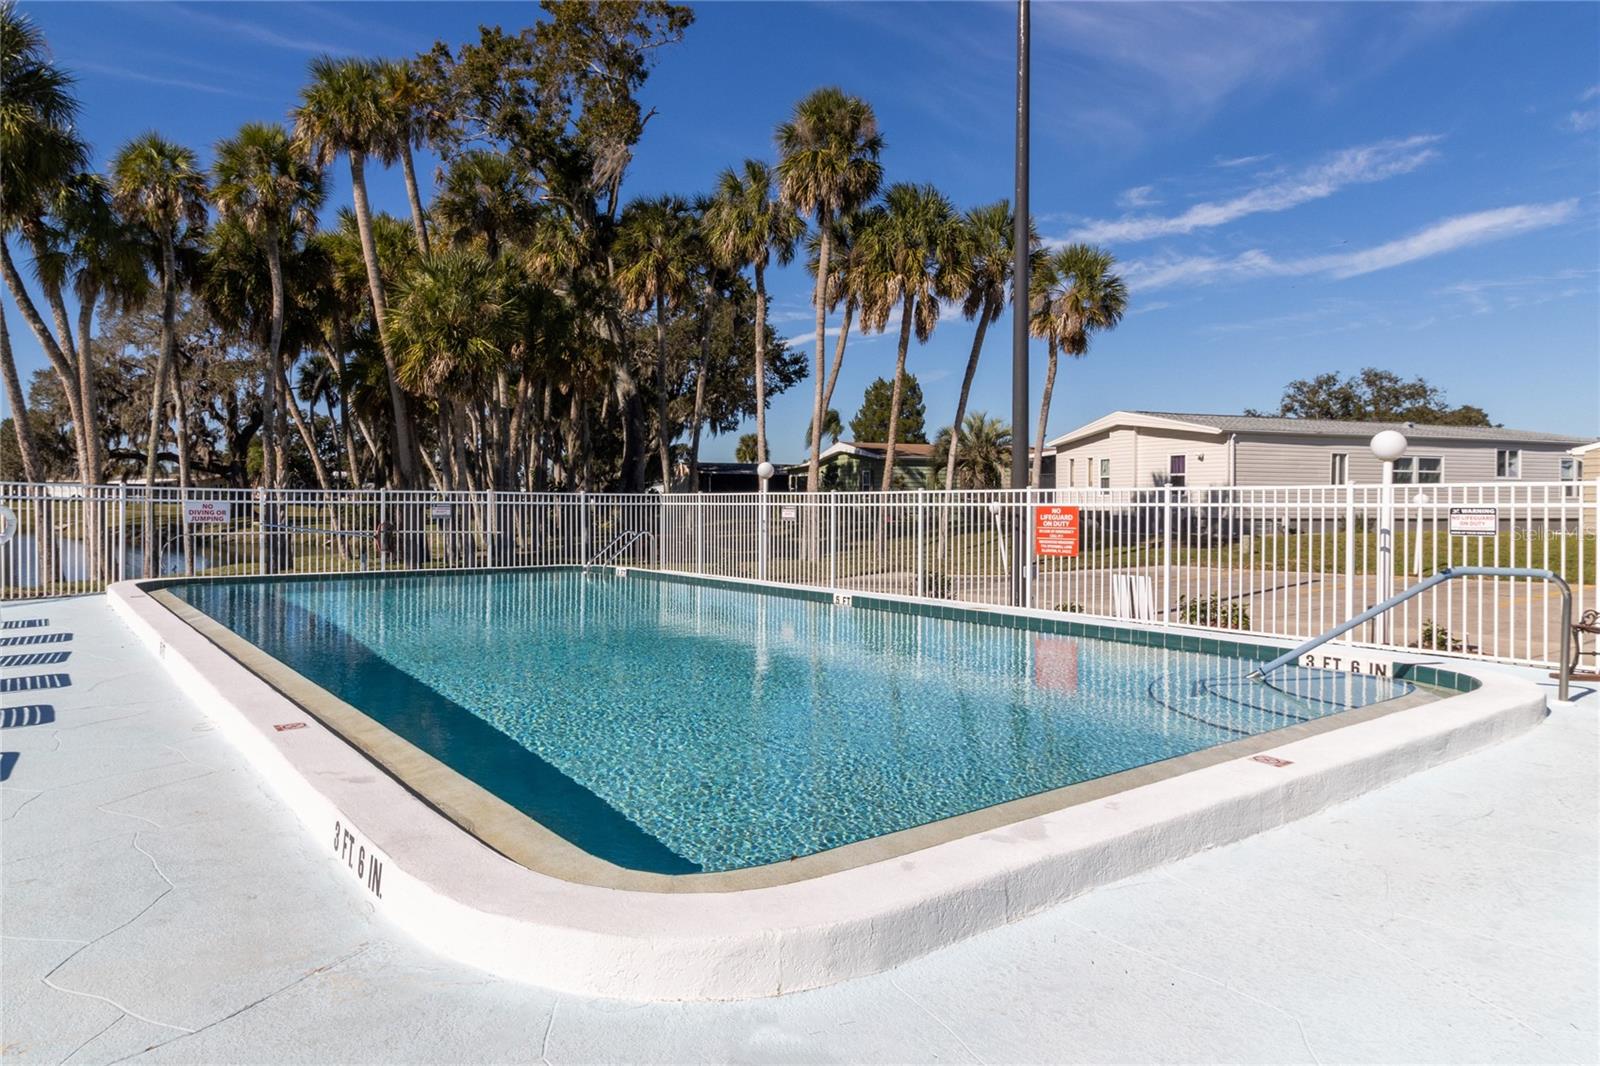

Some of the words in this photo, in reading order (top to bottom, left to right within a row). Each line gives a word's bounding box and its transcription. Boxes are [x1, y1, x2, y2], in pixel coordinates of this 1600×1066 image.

[843, 597, 850, 605] FT
[1306, 655, 1315, 667] 3
[1323, 656, 1341, 670] FT
[1351, 660, 1360, 673] 6
[1369, 662, 1387, 676] IN
[333, 820, 341, 852] 3
[357, 845, 365, 880] 6
[367, 854, 383, 899] IN.
